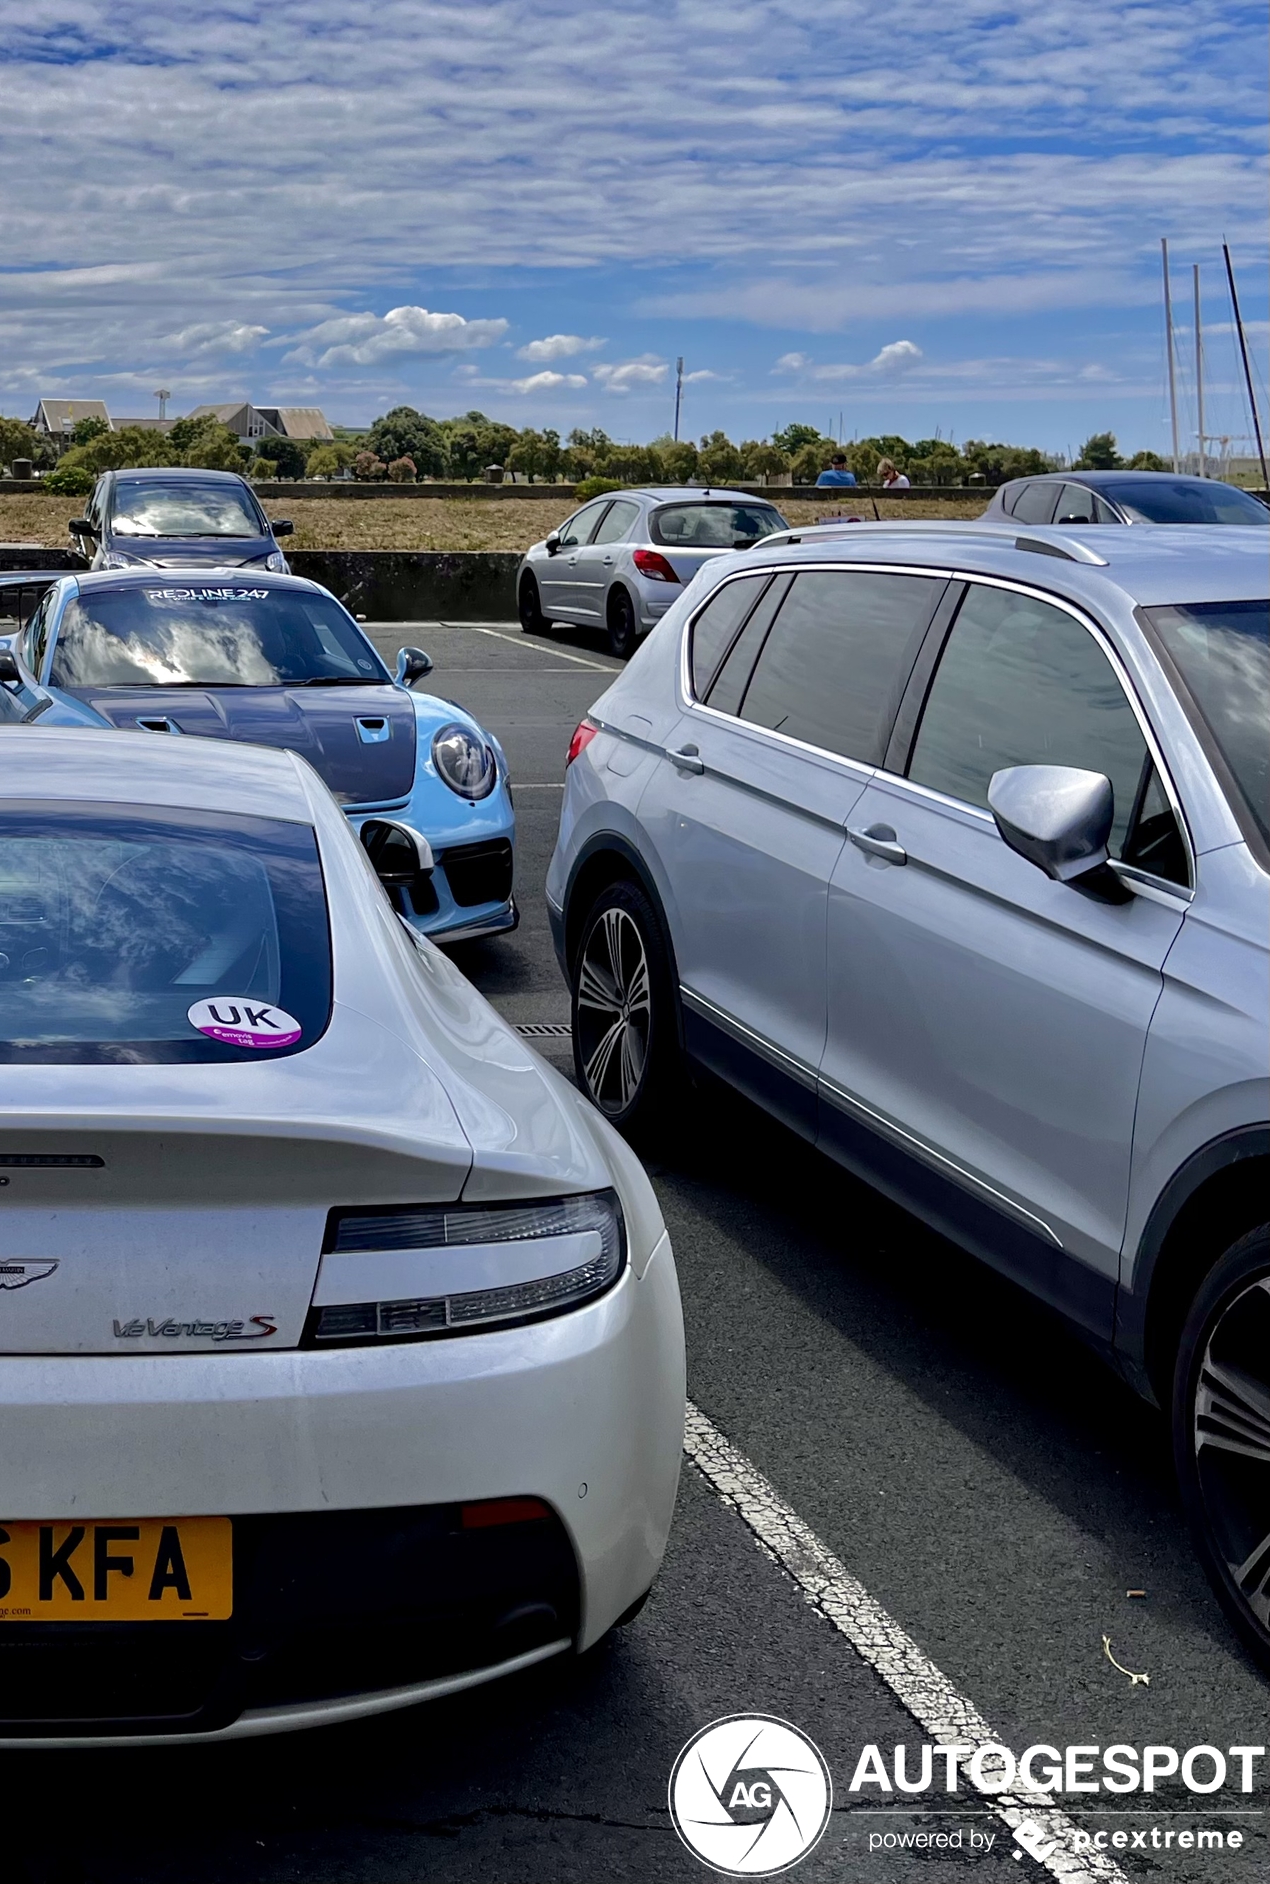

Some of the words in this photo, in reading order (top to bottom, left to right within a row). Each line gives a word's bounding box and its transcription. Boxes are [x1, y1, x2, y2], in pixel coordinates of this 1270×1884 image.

[207, 1004, 282, 1030] UK
[147, 1317, 245, 1342] Vantage
[237, 1314, 278, 1337] S
[38, 1525, 193, 1601] KFA
